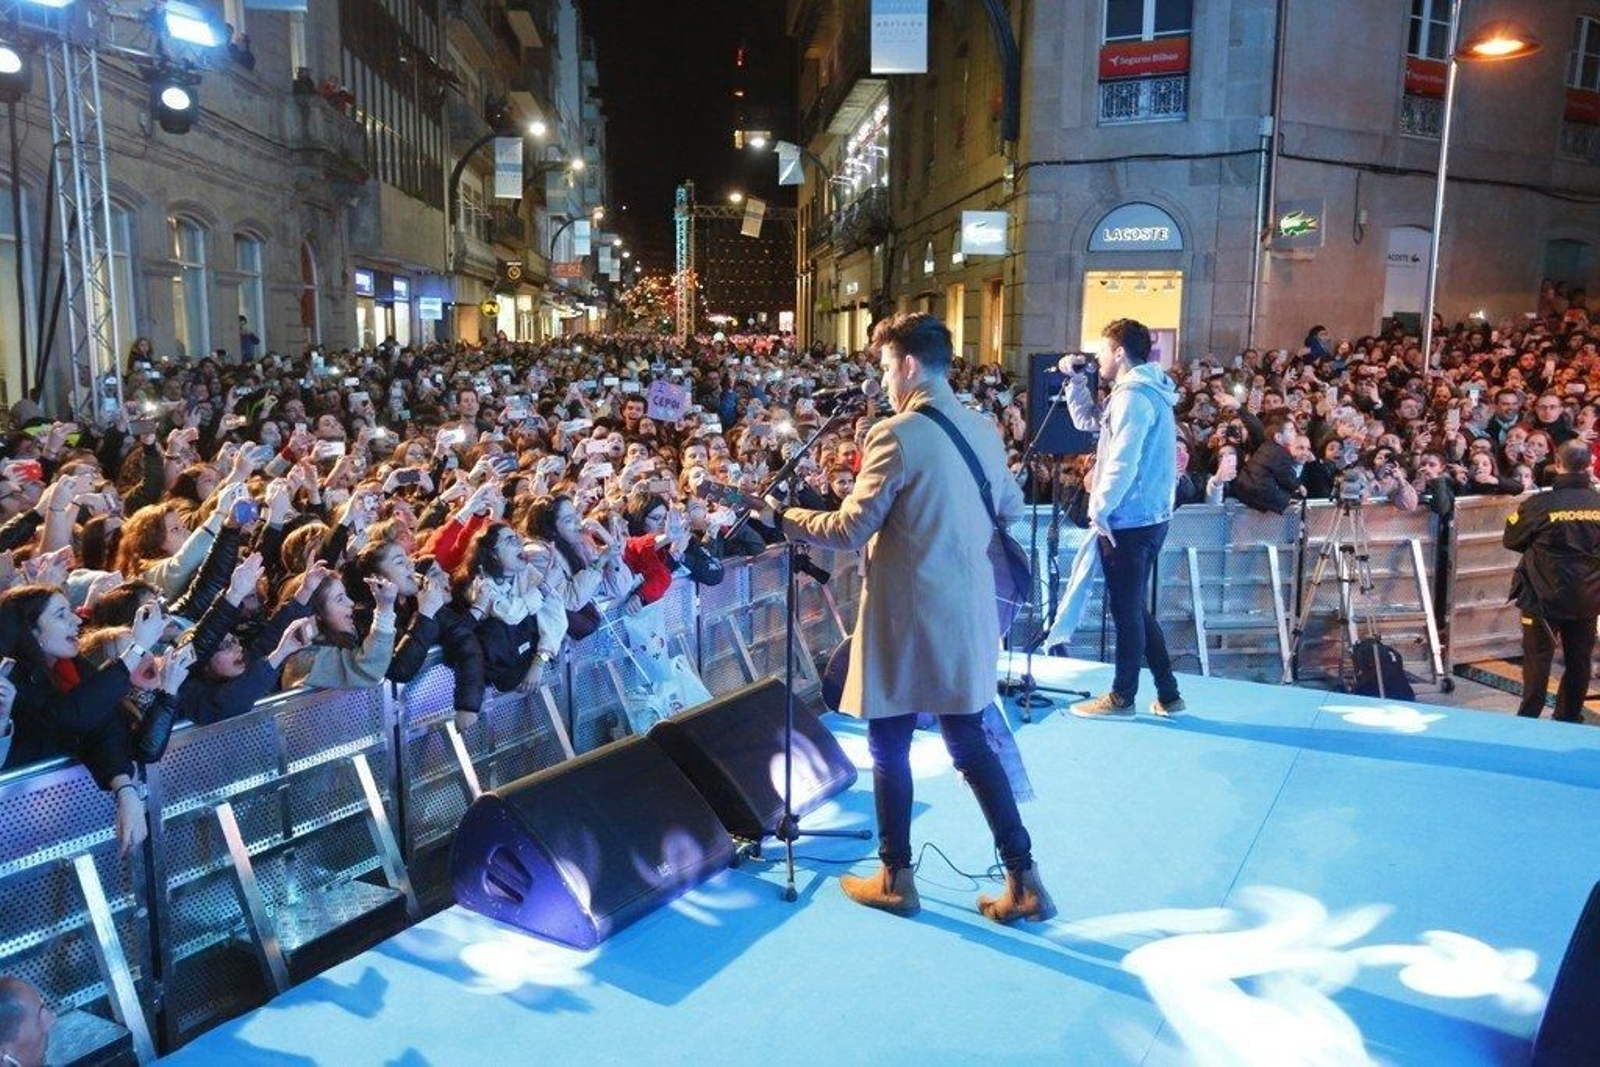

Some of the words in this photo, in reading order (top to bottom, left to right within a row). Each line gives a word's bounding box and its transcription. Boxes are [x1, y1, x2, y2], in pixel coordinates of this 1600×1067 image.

[1119, 56, 1151, 66] Seguros
[1152, 52, 1179, 62] Bilbao
[1103, 227, 1169, 241] LACOSTE
